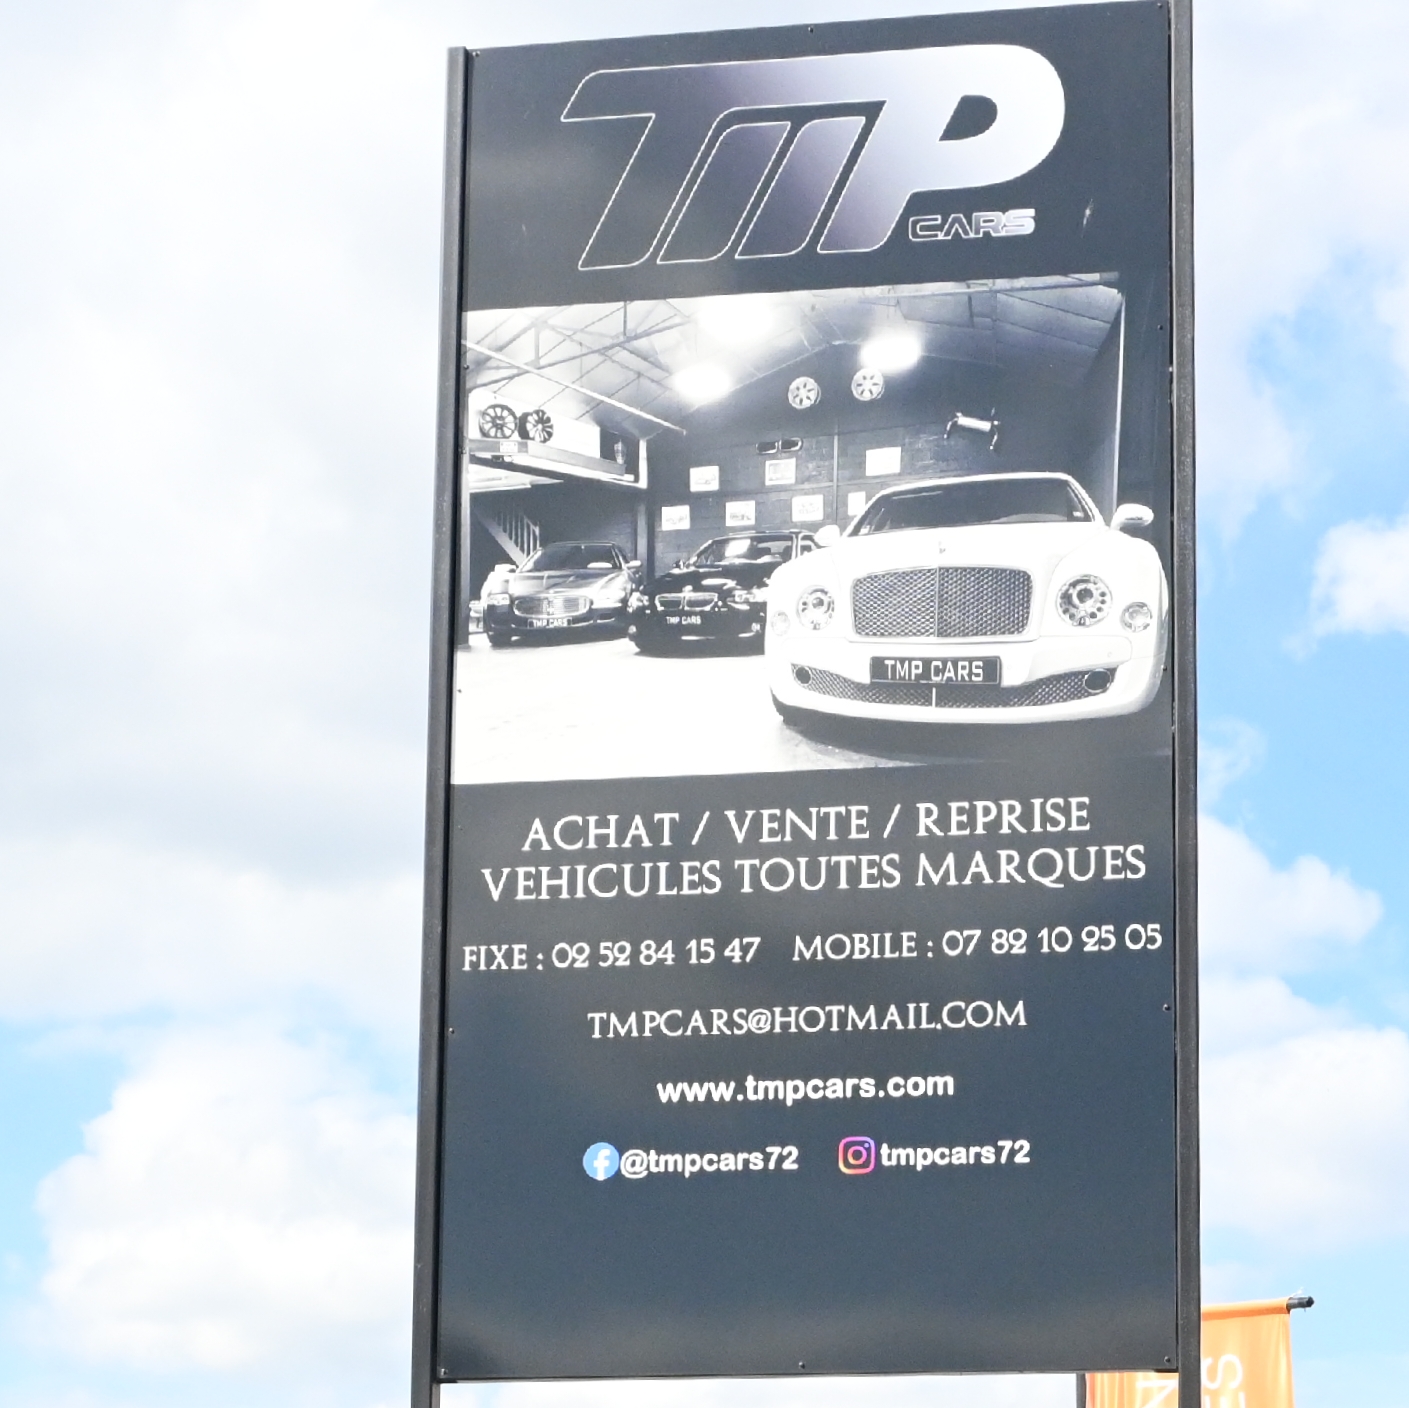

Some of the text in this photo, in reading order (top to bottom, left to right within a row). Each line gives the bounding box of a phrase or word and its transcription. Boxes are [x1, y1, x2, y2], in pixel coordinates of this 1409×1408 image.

[908, 208, 1036, 243] CARS
[532, 618, 569, 629] TMP CARS
[666, 615, 702, 625] TMP CARS
[884, 659, 983, 682] TMP CARS
[521, 797, 1091, 852] ACHAT / VENTE / REPRISE
[481, 844, 1146, 902] VEHICULES TOUTES MARQUES
[462, 943, 528, 971] FIXE
[551, 942, 590, 969] 02
[597, 941, 632, 968] 52
[639, 939, 676, 968] 84
[685, 938, 715, 967] 15
[723, 936, 761, 965] 47
[792, 931, 918, 962] MOBILE
[942, 929, 981, 957] 07
[991, 927, 1028, 955] 82
[1037, 926, 1073, 954] 10
[1081, 924, 1117, 952] 25
[1125, 923, 1163, 951] 05
[587, 1000, 1027, 1039] TMPCARS@HOTMAIL.COM
[656, 1074, 954, 1107] www.tmpcars.com
[619, 1145, 799, 1180] @tmpcars72
[880, 1139, 1031, 1171] tmpcars72
